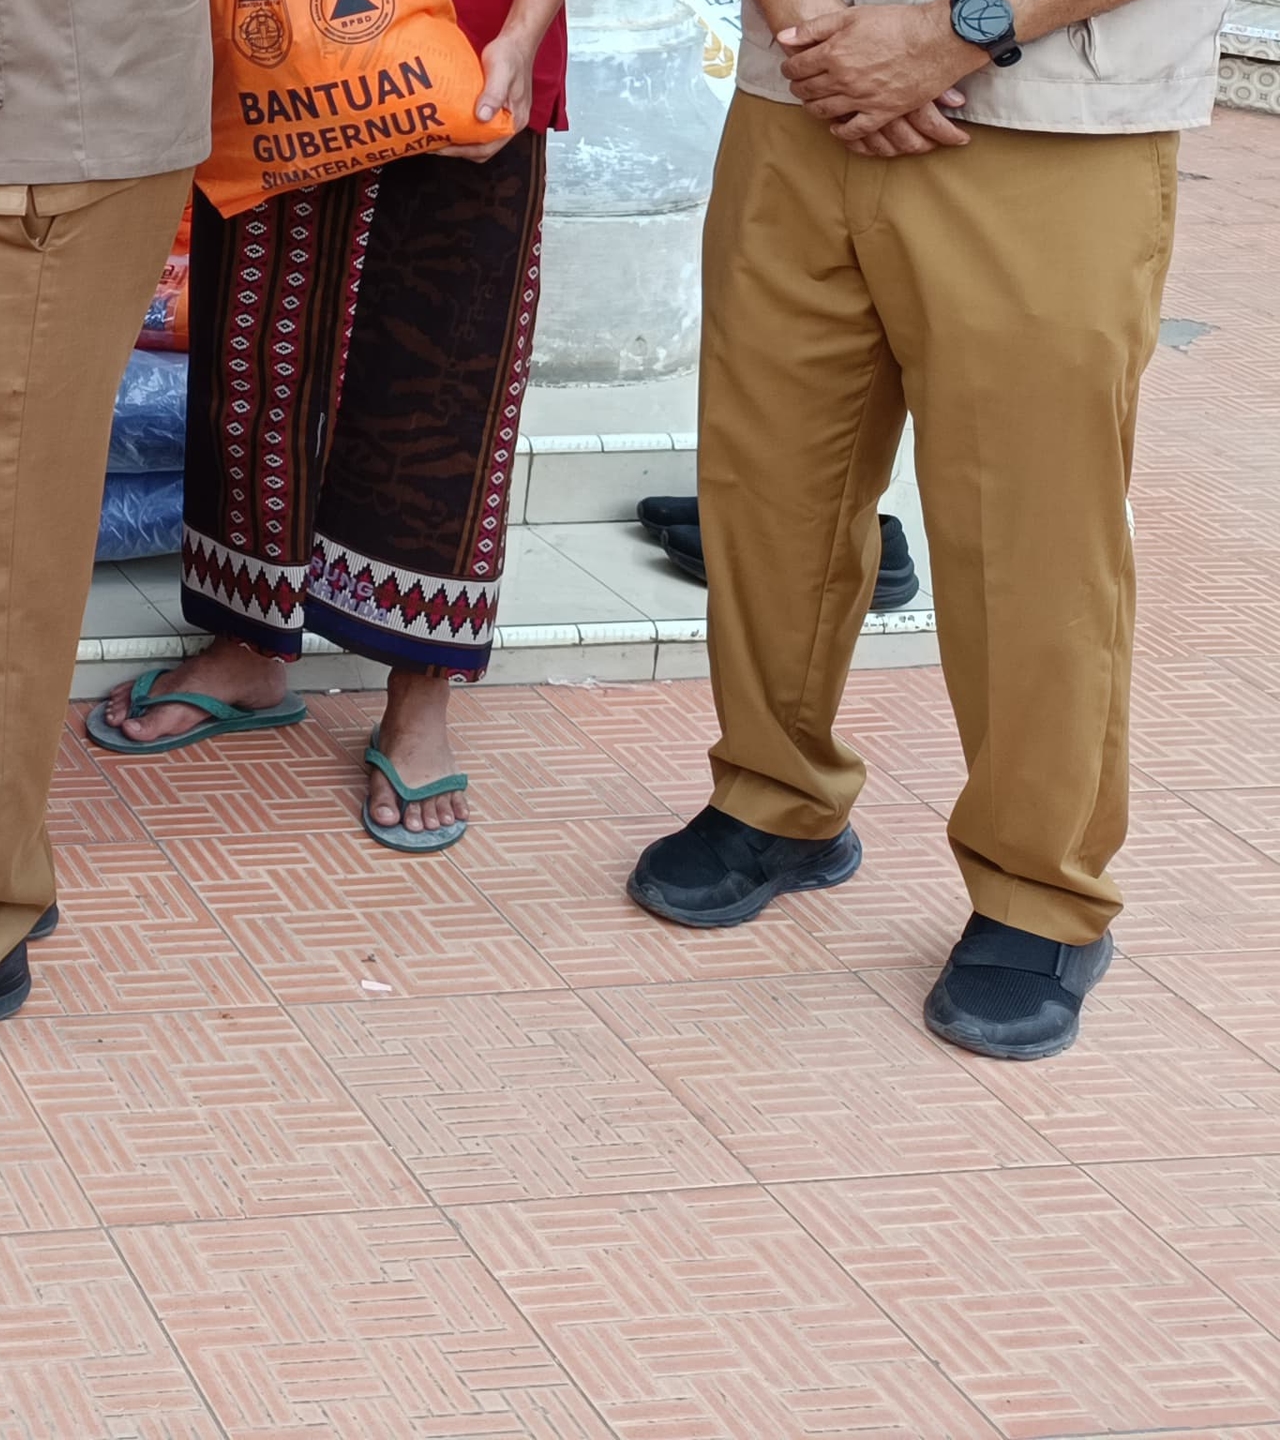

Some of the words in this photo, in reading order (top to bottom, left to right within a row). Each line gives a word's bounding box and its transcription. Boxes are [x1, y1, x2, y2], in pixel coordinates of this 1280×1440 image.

[341, 15, 372, 28] BPBD
[238, 56, 433, 125] BANTUAN
[253, 102, 445, 163] GUBERNUR
[262, 156, 364, 190] SUMATERA
[365, 134, 451, 162] SELATAN
